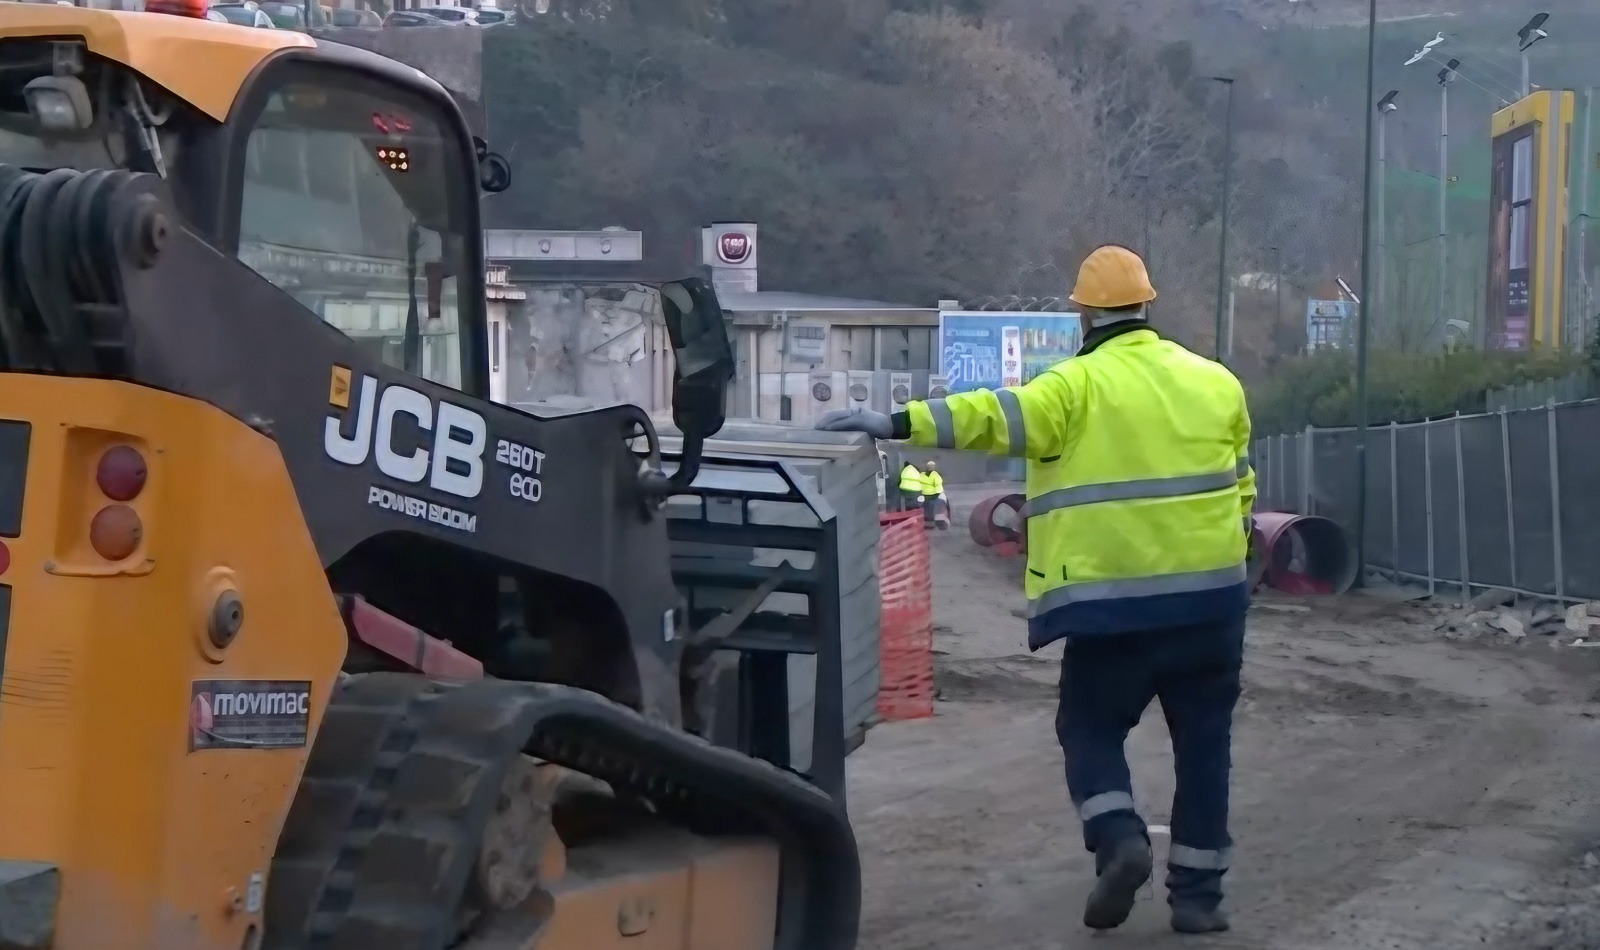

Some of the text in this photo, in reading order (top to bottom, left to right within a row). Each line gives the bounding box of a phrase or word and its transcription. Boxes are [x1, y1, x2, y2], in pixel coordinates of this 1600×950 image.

[324, 374, 487, 498] JCB
[368, 486, 427, 519] POWER
[213, 692, 309, 716] movimac
